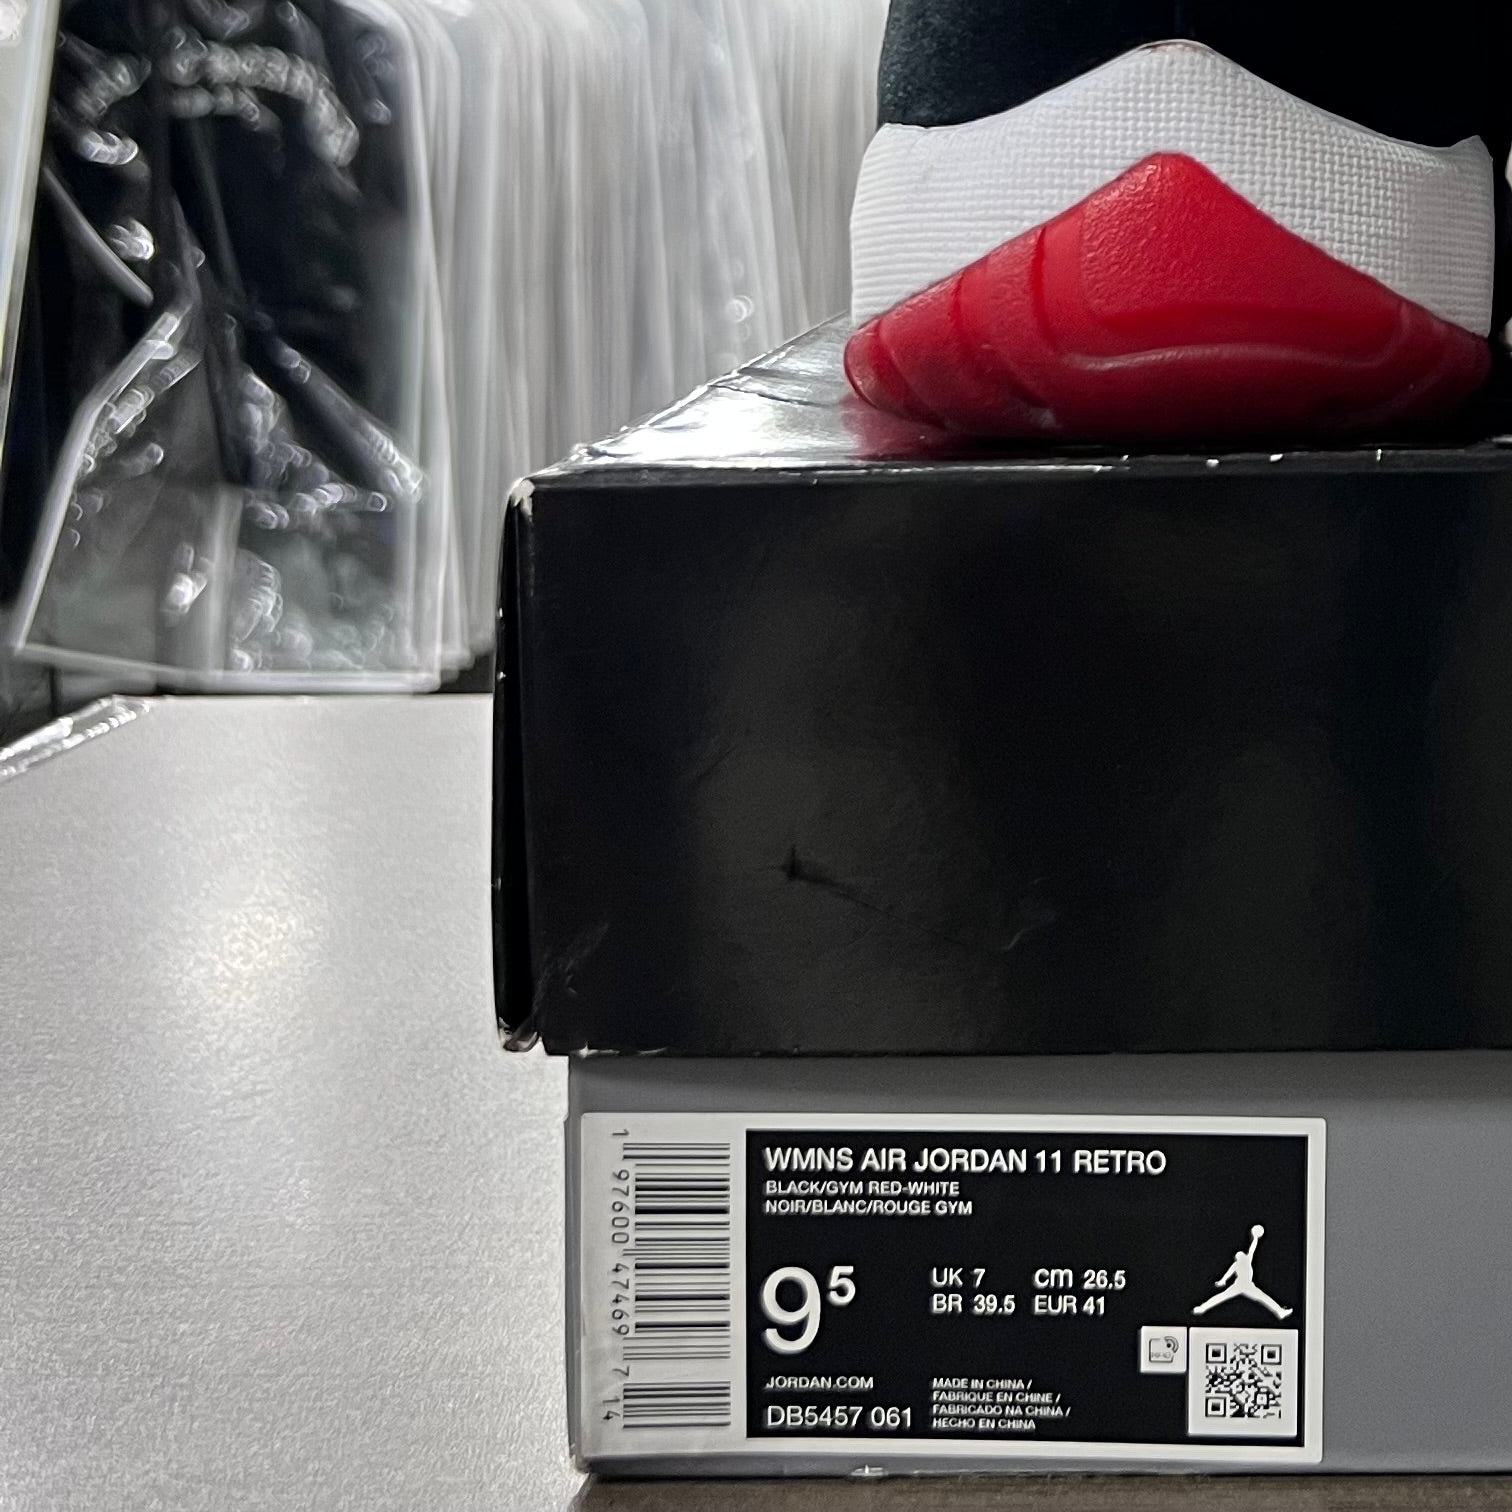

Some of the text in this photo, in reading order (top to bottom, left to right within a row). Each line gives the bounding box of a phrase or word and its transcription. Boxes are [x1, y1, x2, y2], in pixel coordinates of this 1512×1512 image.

[765, 1147, 1167, 1175] WMNS AIR JORDAN 11 RETRO
[766, 1180, 960, 1197] BLACK/GYM RED-WHITE
[766, 1199, 973, 1216] NOIR/BLANC/ROUGE GYM
[933, 1268, 986, 1288] UK 7
[1084, 1269, 1126, 1290] 26.5
[933, 1293, 1016, 1315] BR 39.5
[1035, 1294, 1105, 1316] EUR 41
[766, 1375, 874, 1391] JORDAN.COM
[933, 1378, 968, 1389] MADE
[971, 1379, 984, 1389] IN
[986, 1379, 1025, 1390] CHINA
[933, 1390, 993, 1403] FABRIQUE
[997, 1392, 1013, 1403] EN
[1015, 1392, 1053, 1404] CHINE
[768, 1405, 911, 1428] DB5457 061
[933, 1404, 1003, 1416] FABRICADO
[1005, 1405, 1023, 1416] NA
[1025, 1406, 1064, 1417] CHINA
[933, 1417, 1036, 1430] HECHO EN CHINA
